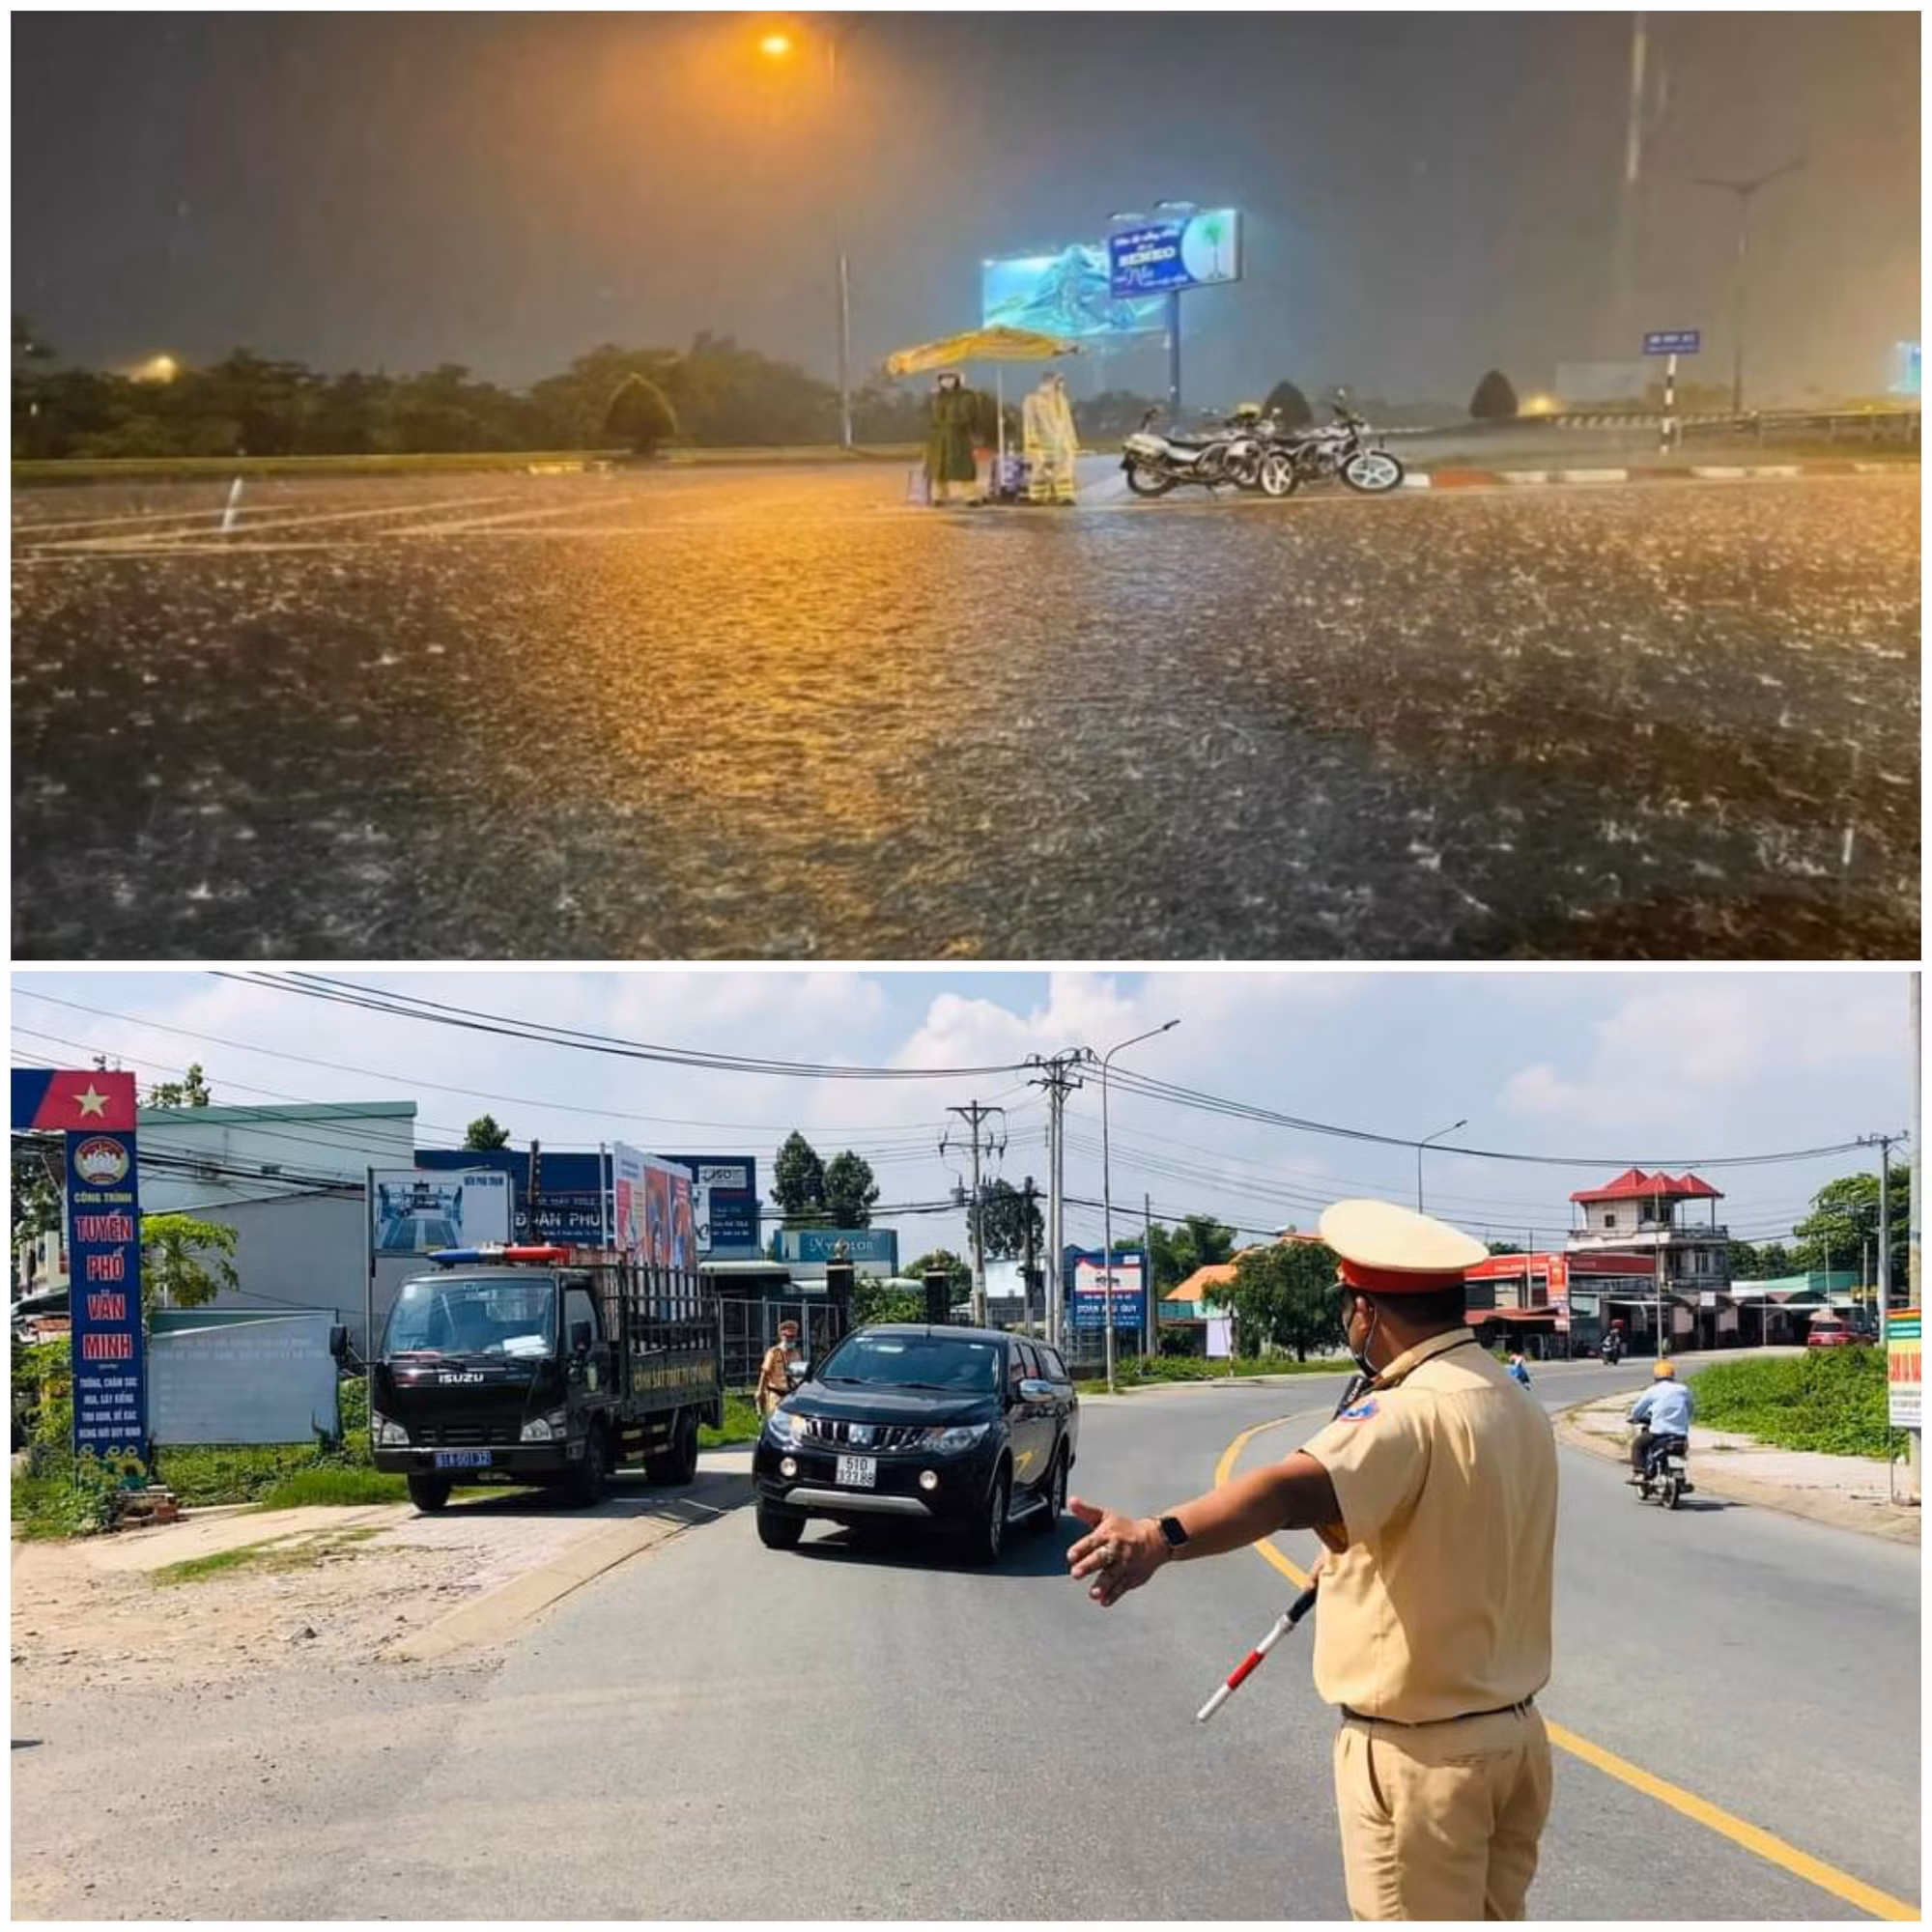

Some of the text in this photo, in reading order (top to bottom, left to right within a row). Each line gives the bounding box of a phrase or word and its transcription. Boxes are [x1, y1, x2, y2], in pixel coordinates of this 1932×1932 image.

[74, 1208, 133, 1242] TUYẾN
[86, 1246, 125, 1281] PHỐ
[87, 1289, 126, 1321] VĂN
[82, 1333, 133, 1360] MINH
[439, 1373, 484, 1384] ISUZU
